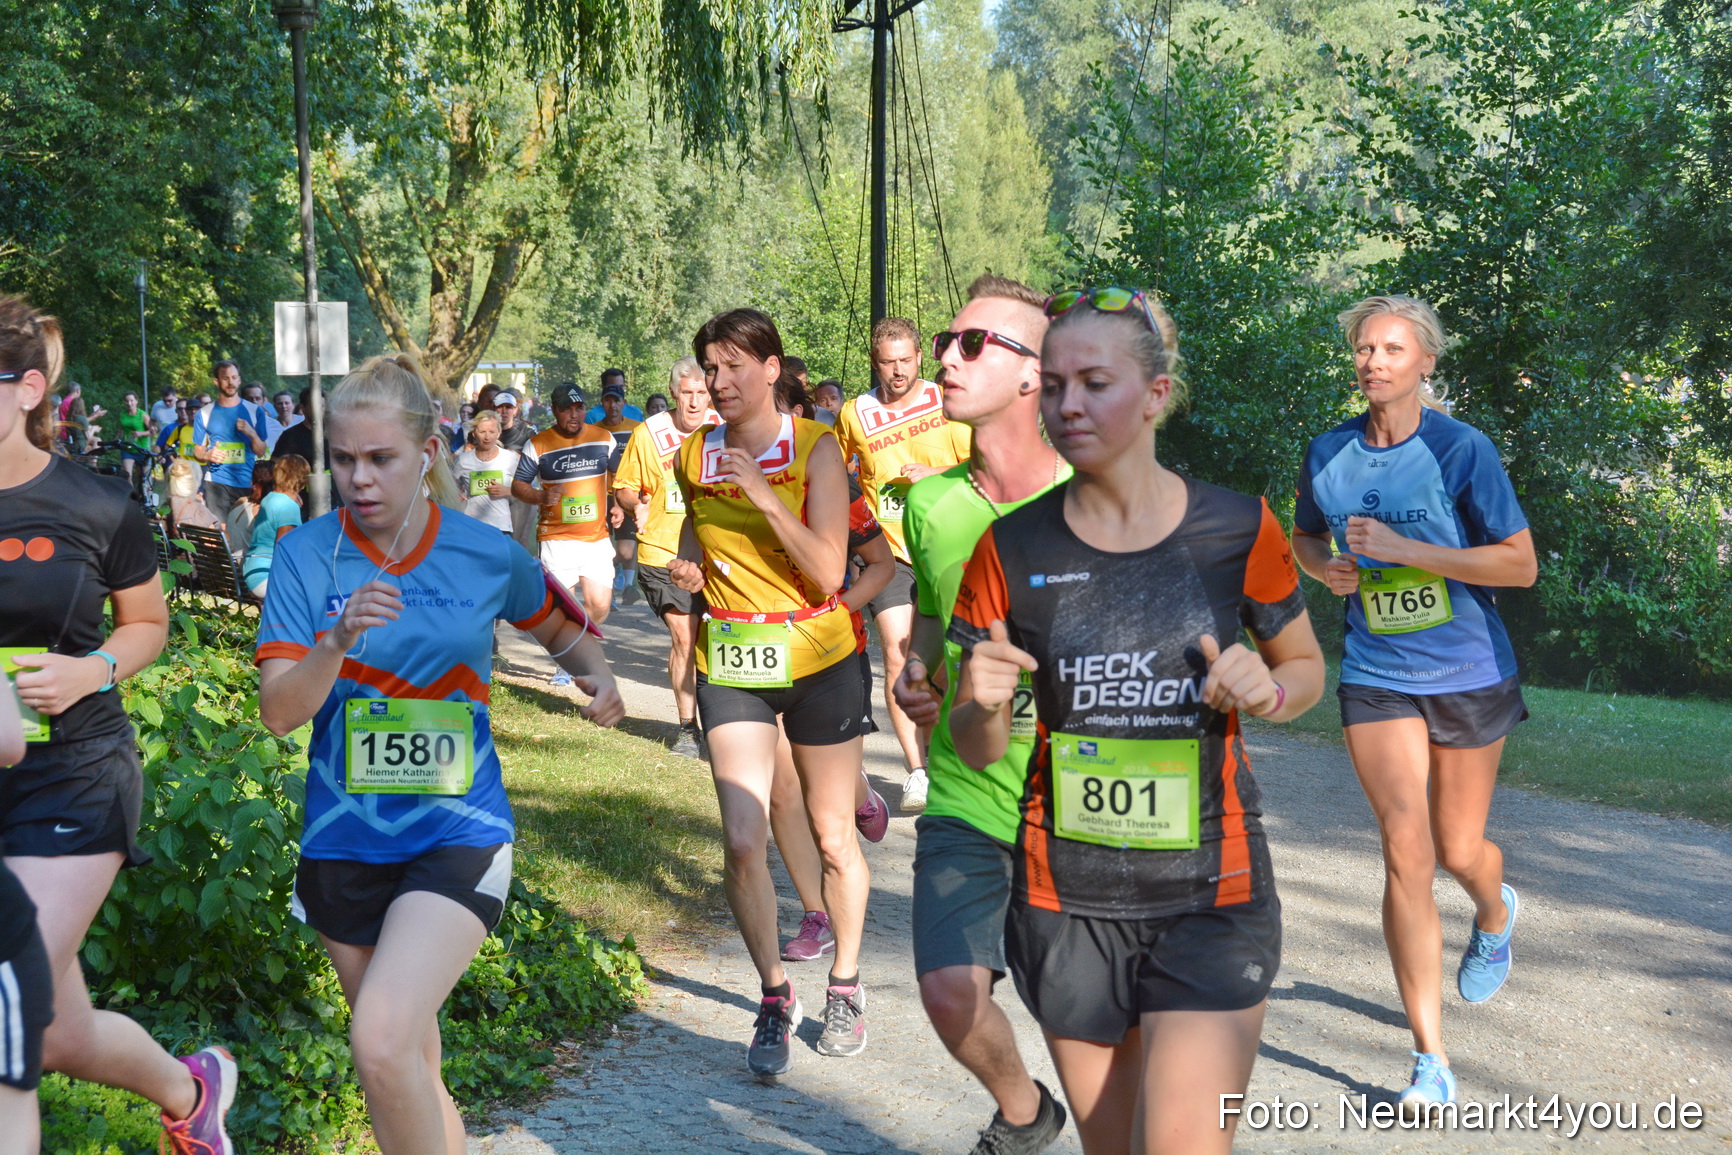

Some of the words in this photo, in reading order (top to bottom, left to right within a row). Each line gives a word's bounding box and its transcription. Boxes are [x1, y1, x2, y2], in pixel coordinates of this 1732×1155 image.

[868, 431, 905, 454] MAX
[908, 416, 948, 437] BÖGL
[561, 458, 599, 470] Fischer
[570, 504, 591, 516] 615
[460, 599, 474, 607] eG
[1371, 586, 1436, 615] 1766
[1381, 614, 1410, 623] Mishkine
[1412, 611, 1430, 620] Yulia
[717, 643, 777, 669] 1318
[1058, 651, 1158, 682] HECK
[1359, 662, 1475, 678] www.schabmueller.de
[1072, 677, 1206, 711] DESIGN
[1133, 711, 1199, 727] Werbung!
[361, 733, 455, 766] 1580
[366, 768, 399, 777] Hiemer
[1083, 777, 1156, 817] 801
[1078, 813, 1122, 827] Gebhard
[1126, 818, 1170, 829] Theresa
[1106, 828, 1132, 838] Design
[1134, 829, 1158, 837] GmbH
